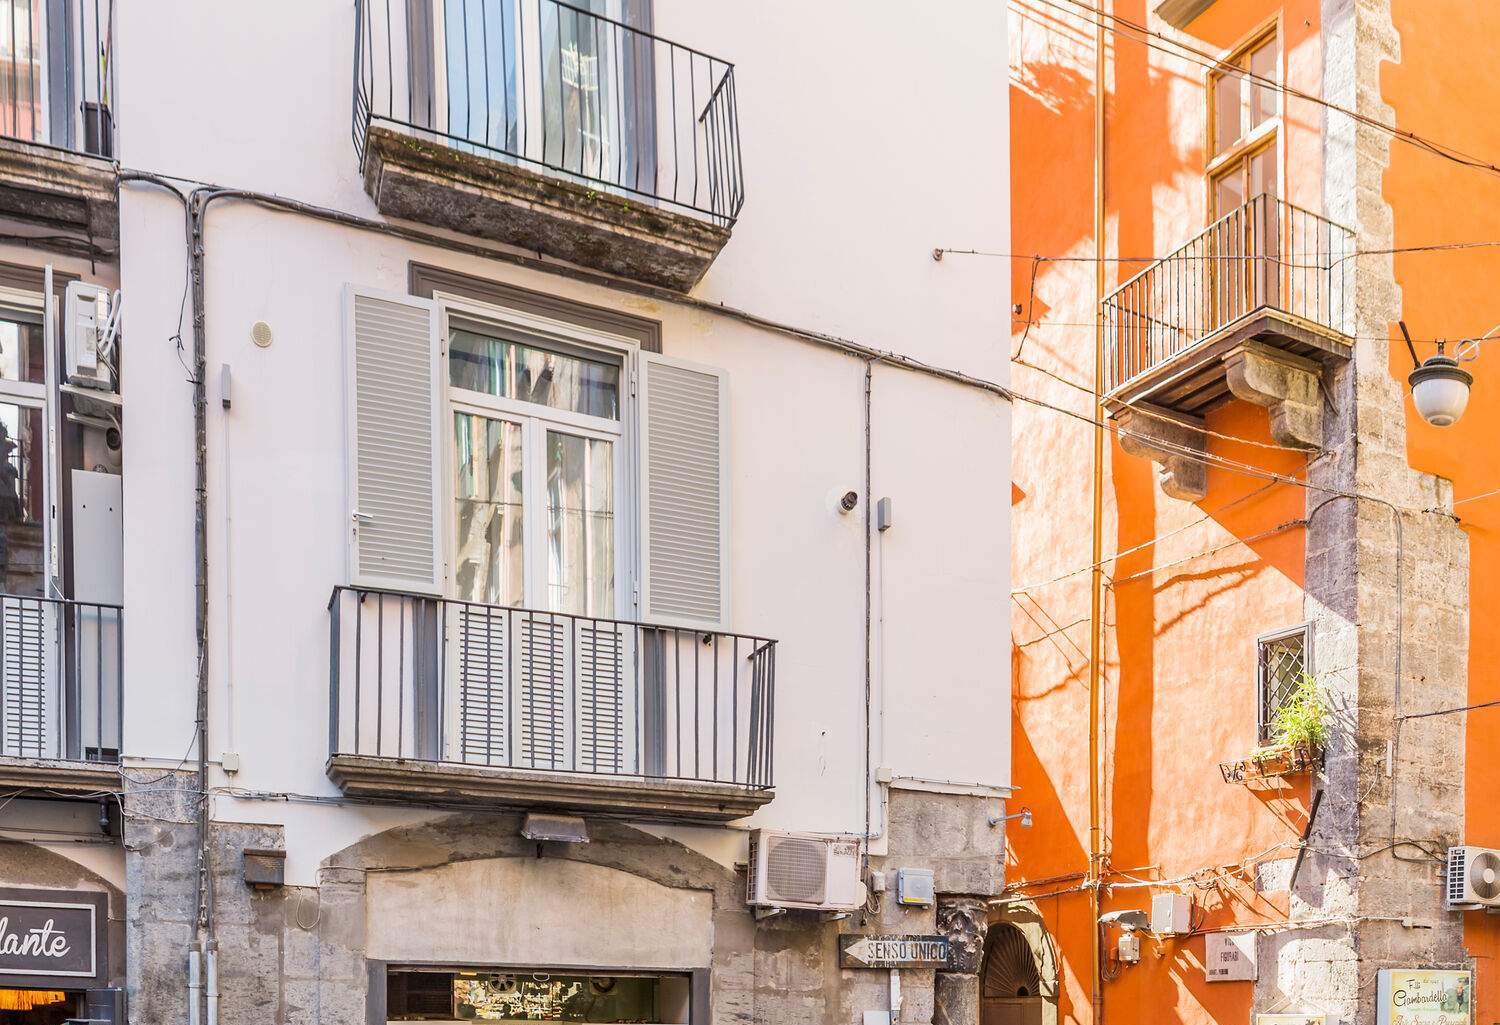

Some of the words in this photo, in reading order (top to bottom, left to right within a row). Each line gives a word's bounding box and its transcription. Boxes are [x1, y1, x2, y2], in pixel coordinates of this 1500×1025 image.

[868, 942, 907, 959] SENSO
[910, 942, 946, 960] UNICO
[1393, 989, 1448, 1007] Gambardella
